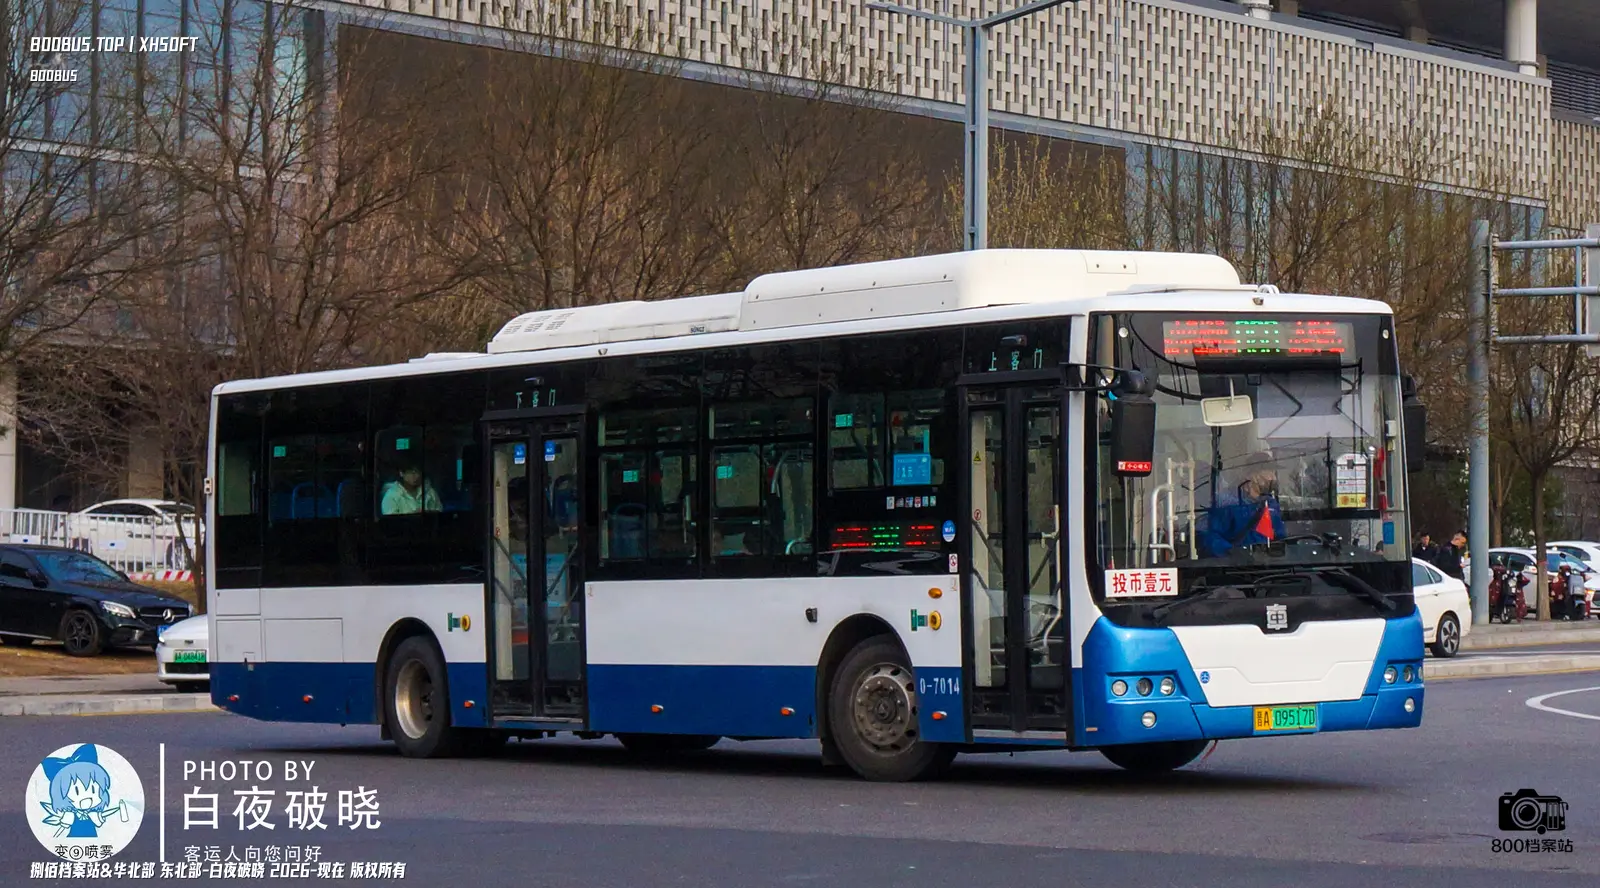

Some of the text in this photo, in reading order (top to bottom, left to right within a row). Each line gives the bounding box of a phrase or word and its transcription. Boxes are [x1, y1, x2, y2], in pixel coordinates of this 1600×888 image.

[1113, 571, 1172, 594] 投币壹元
[920, 677, 960, 695] 0-7014
